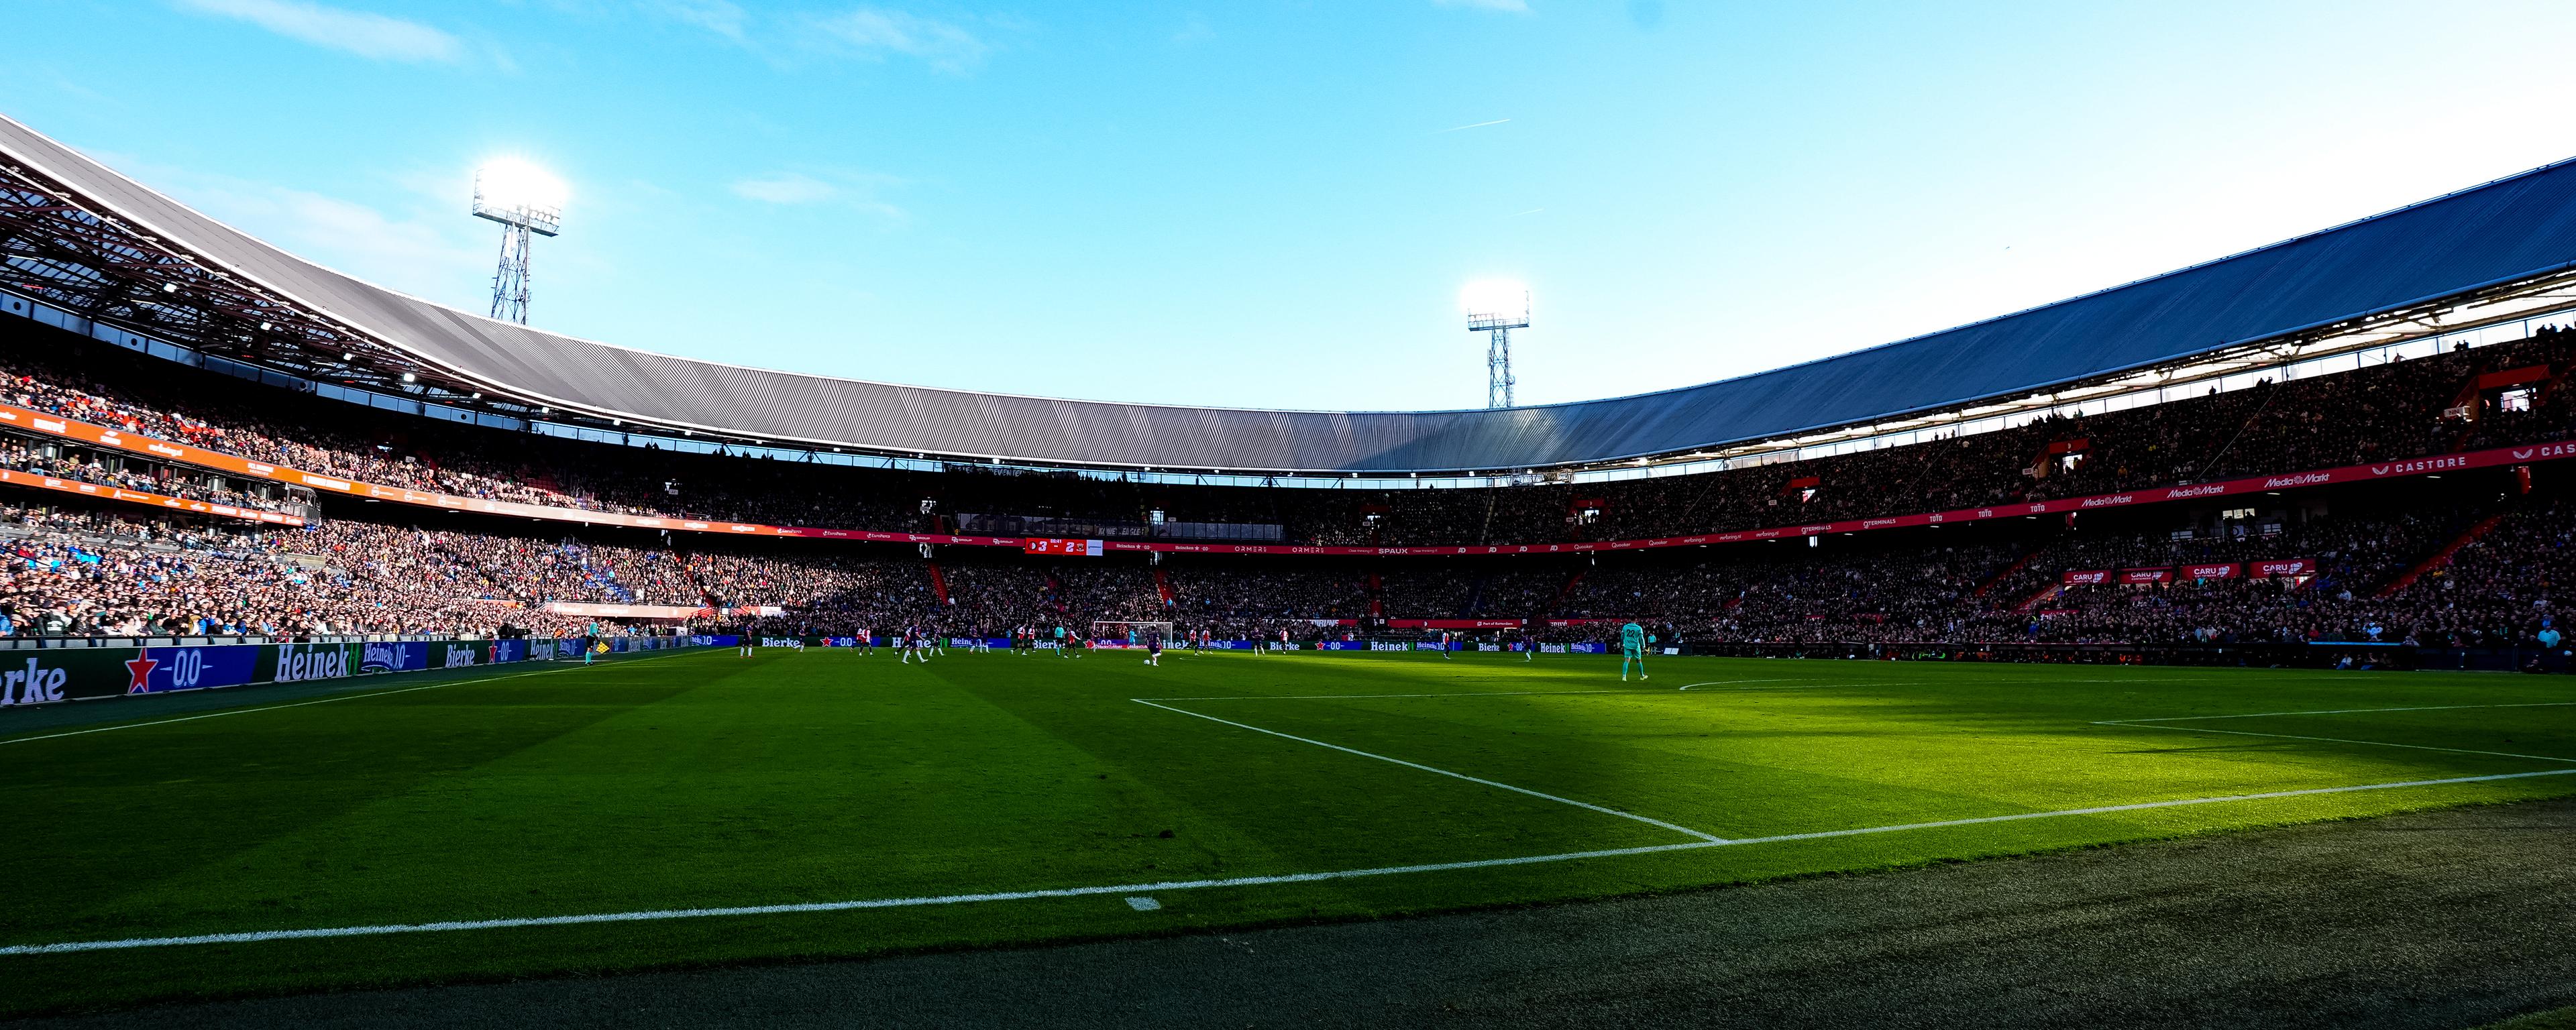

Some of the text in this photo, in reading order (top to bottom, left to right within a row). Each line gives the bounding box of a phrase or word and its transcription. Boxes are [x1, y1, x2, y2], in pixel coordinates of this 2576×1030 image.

[2540, 443, 2576, 457] CAS
[2396, 457, 2466, 473] CASTORE
[2264, 473, 2330, 488] Media Markt
[2167, 485, 2224, 498] Media Markt
[2081, 495, 2133, 507] Media Markt
[1978, 509, 1992, 518] TOTO
[2030, 504, 2045, 512] TOTO
[1929, 514, 1943, 522] TOTO
[1038, 541, 1047, 551] 3
[1065, 542, 1075, 553] 2
[1626, 629, 1635, 638] 22
[762, 637, 801, 648] Bierke
[840, 637, 853, 647] 0.0
[1371, 642, 1408, 651] Heinek
[1479, 643, 1500, 651] Bierke
[1540, 643, 1566, 653] Heinek
[445, 644, 475, 667] Bierke
[173, 649, 201, 687] 0.0
[274, 643, 349, 683] Heinek
[0, 657, 66, 705] rke
